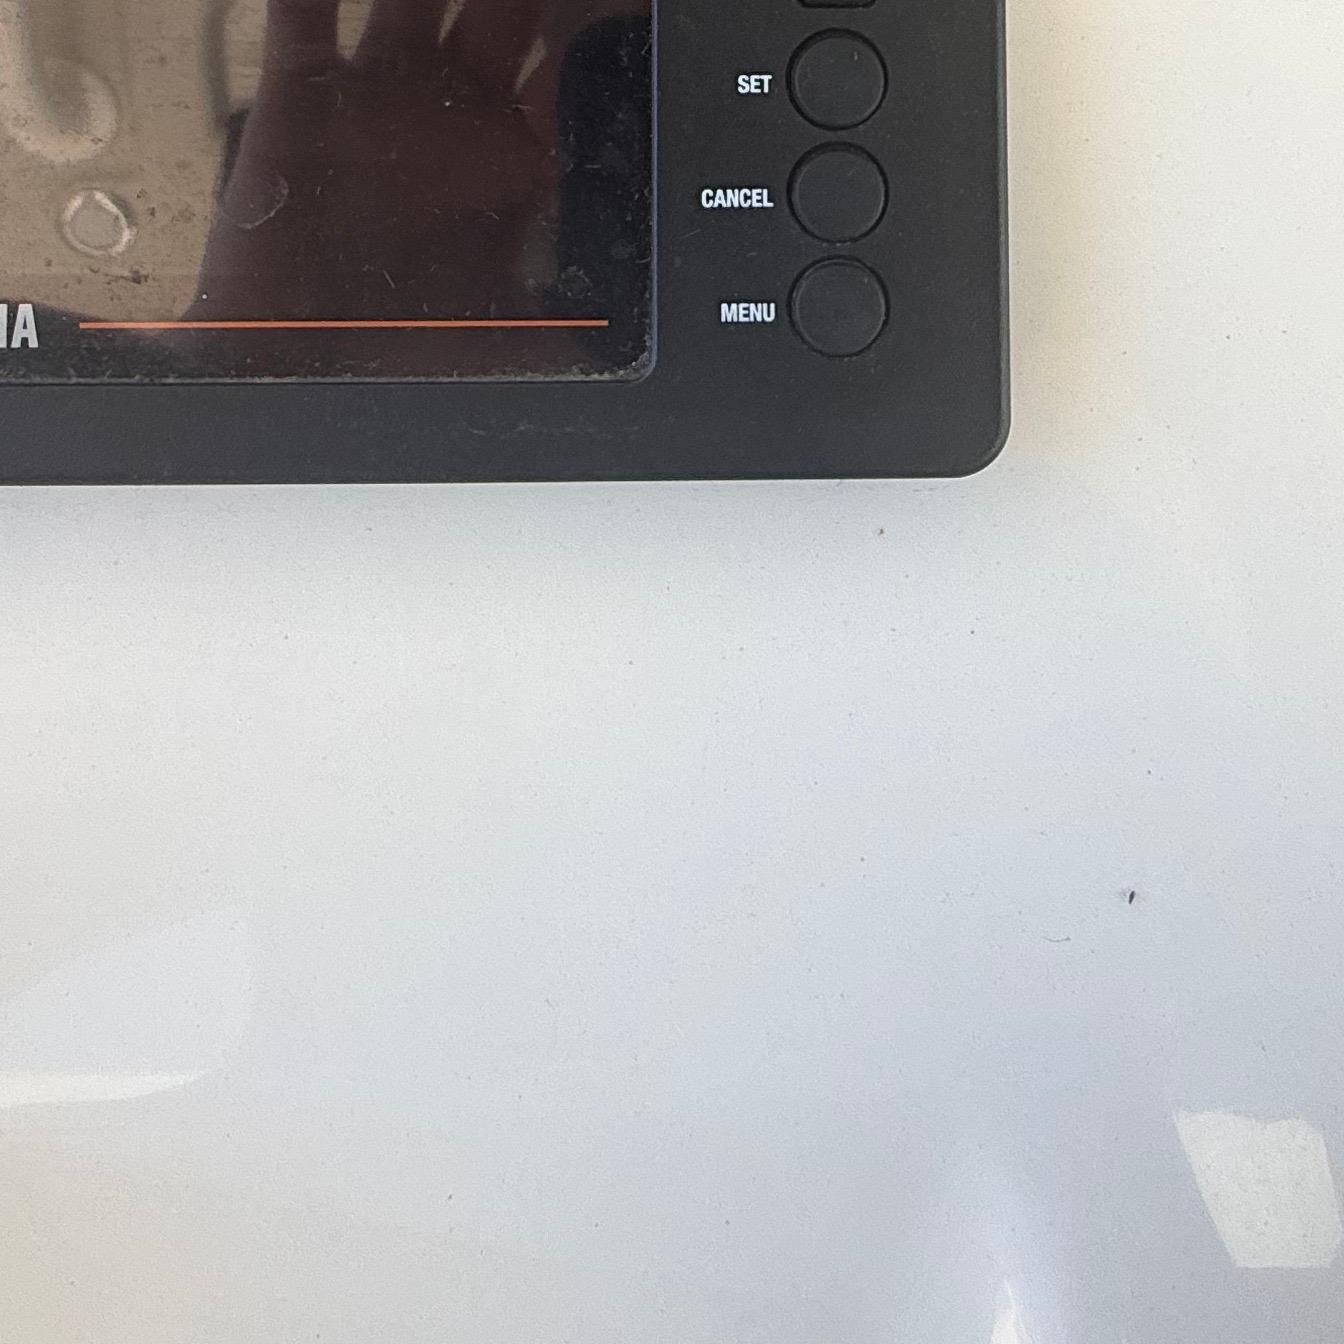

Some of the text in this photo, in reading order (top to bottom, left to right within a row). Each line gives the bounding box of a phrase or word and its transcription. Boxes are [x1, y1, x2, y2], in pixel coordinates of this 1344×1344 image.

[737, 74, 773, 94] SET
[701, 189, 774, 208] CANCEL
[720, 303, 776, 323] MENU
